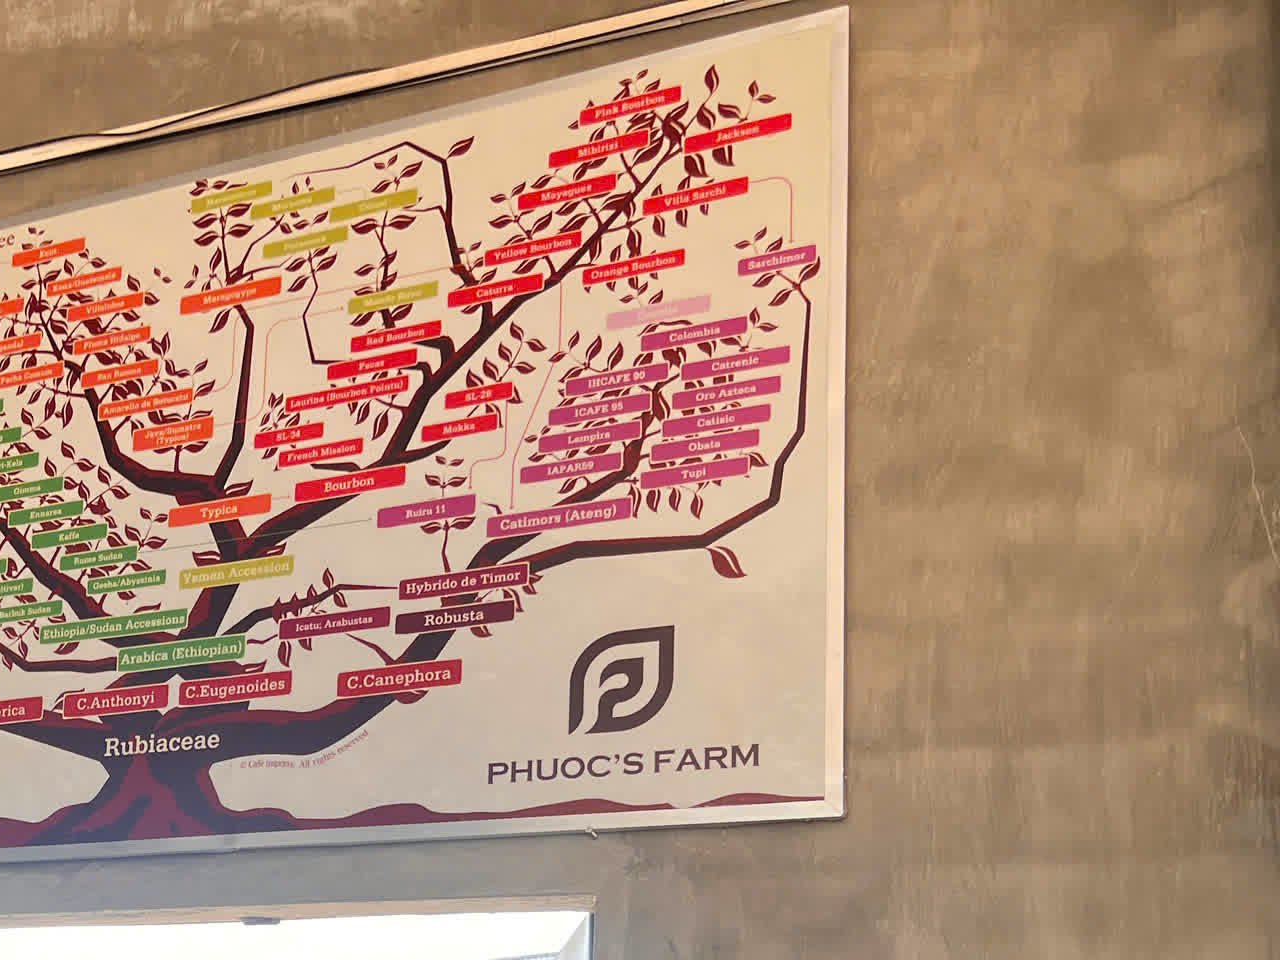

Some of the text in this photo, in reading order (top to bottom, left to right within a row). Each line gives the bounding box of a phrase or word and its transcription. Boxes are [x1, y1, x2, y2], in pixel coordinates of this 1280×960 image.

[494, 246, 528, 261] Yellow
[591, 256, 676, 278] Orange Bourbon
[386, 327, 425, 341] Bourbon
[669, 326, 721, 341] Colombia
[568, 432, 611, 445] Lempira
[287, 443, 356, 462] French Mission
[324, 476, 375, 492] Bourbon
[200, 504, 238, 519] Typica
[435, 505, 447, 515] 11
[500, 505, 617, 531] Catimors (Ateng)
[229, 559, 289, 578] Accession
[405, 570, 521, 596] Hybrido de Timor
[43, 614, 186, 640] Ethiopia/Sudan Accessions
[324, 615, 373, 630] Arabustas
[424, 610, 485, 627] Robusta
[121, 640, 243, 666] Arabica (Ethiopian)
[185, 678, 286, 699] C.Eugenoides
[347, 668, 452, 690] C.Canephora
[77, 690, 156, 711] C.Anthonyi
[104, 732, 221, 757] Rubiaceae
[487, 743, 760, 784] PHUOC'S FARM
